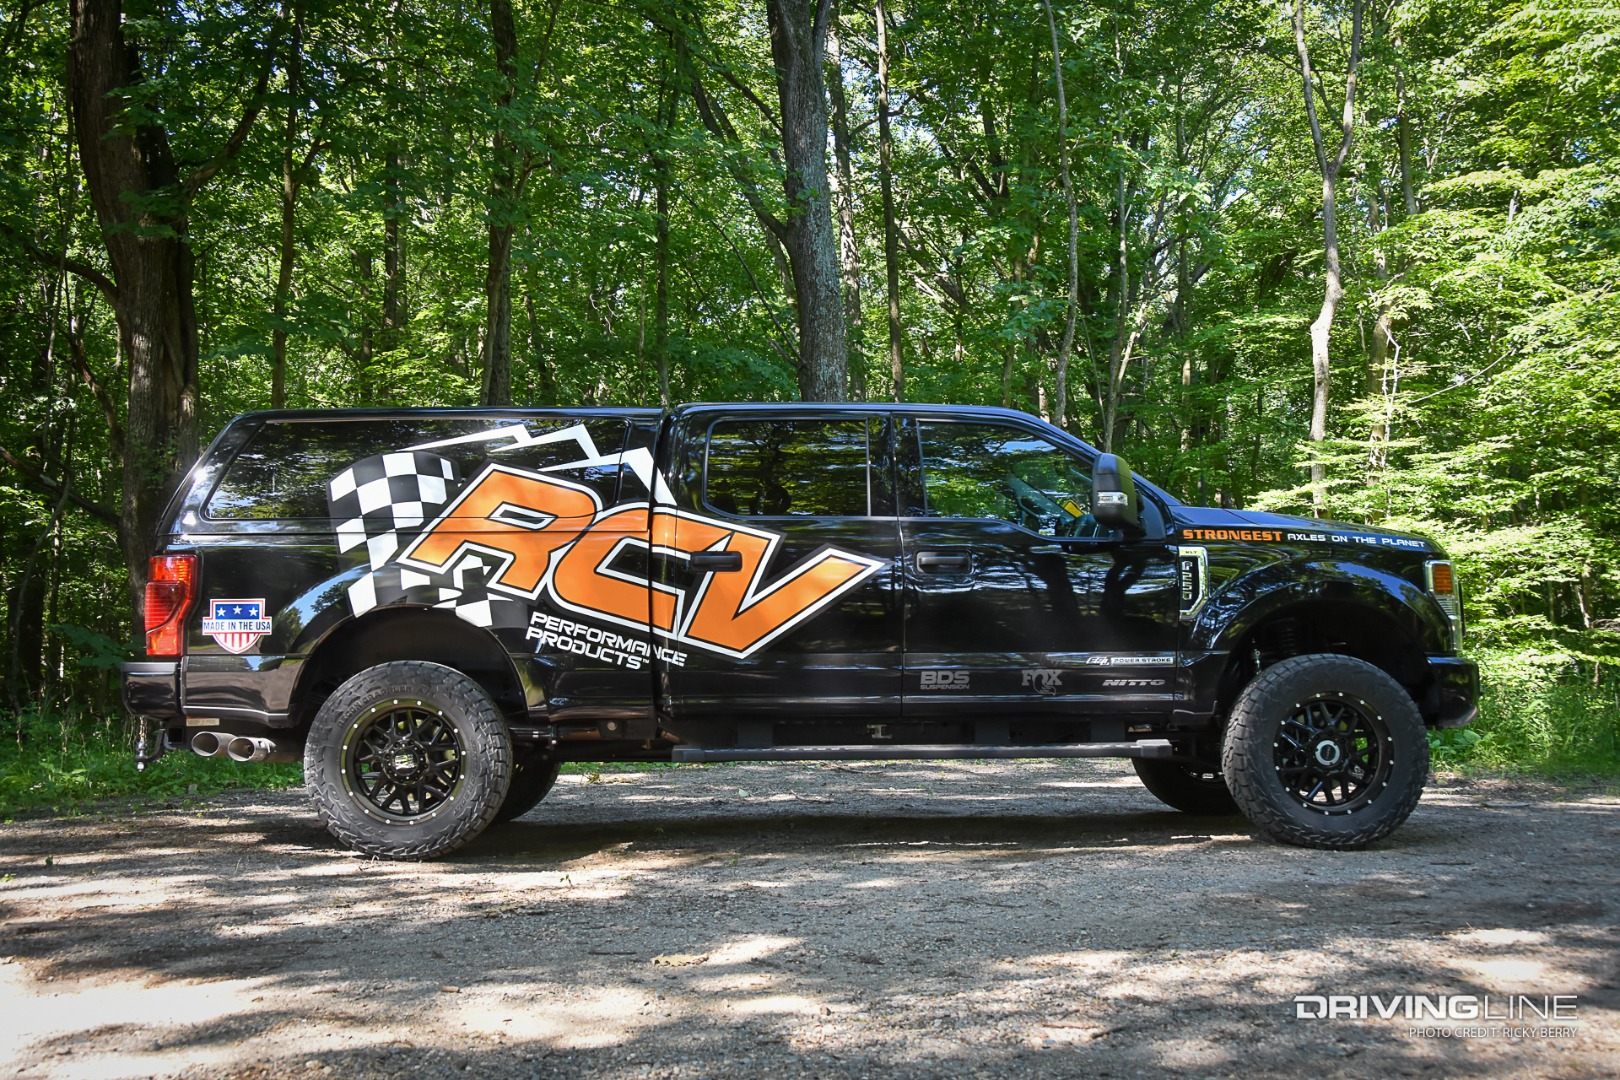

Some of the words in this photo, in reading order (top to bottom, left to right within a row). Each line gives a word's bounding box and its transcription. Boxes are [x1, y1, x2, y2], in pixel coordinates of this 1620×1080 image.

[1183, 529, 1282, 542] STRONGEST
[1287, 533, 1326, 542] AXLES
[1332, 535, 1348, 543] ON
[1353, 536, 1376, 544] THE
[1382, 538, 1425, 548] PLANET
[396, 462, 886, 660] RCV
[203, 621, 225, 631] MADE
[228, 621, 236, 631] IN
[239, 621, 253, 631] THE
[255, 621, 271, 631] USA
[530, 611, 688, 667] PERFORMANCE
[920, 671, 970, 684] BDS
[1021, 669, 1063, 695] FOX
